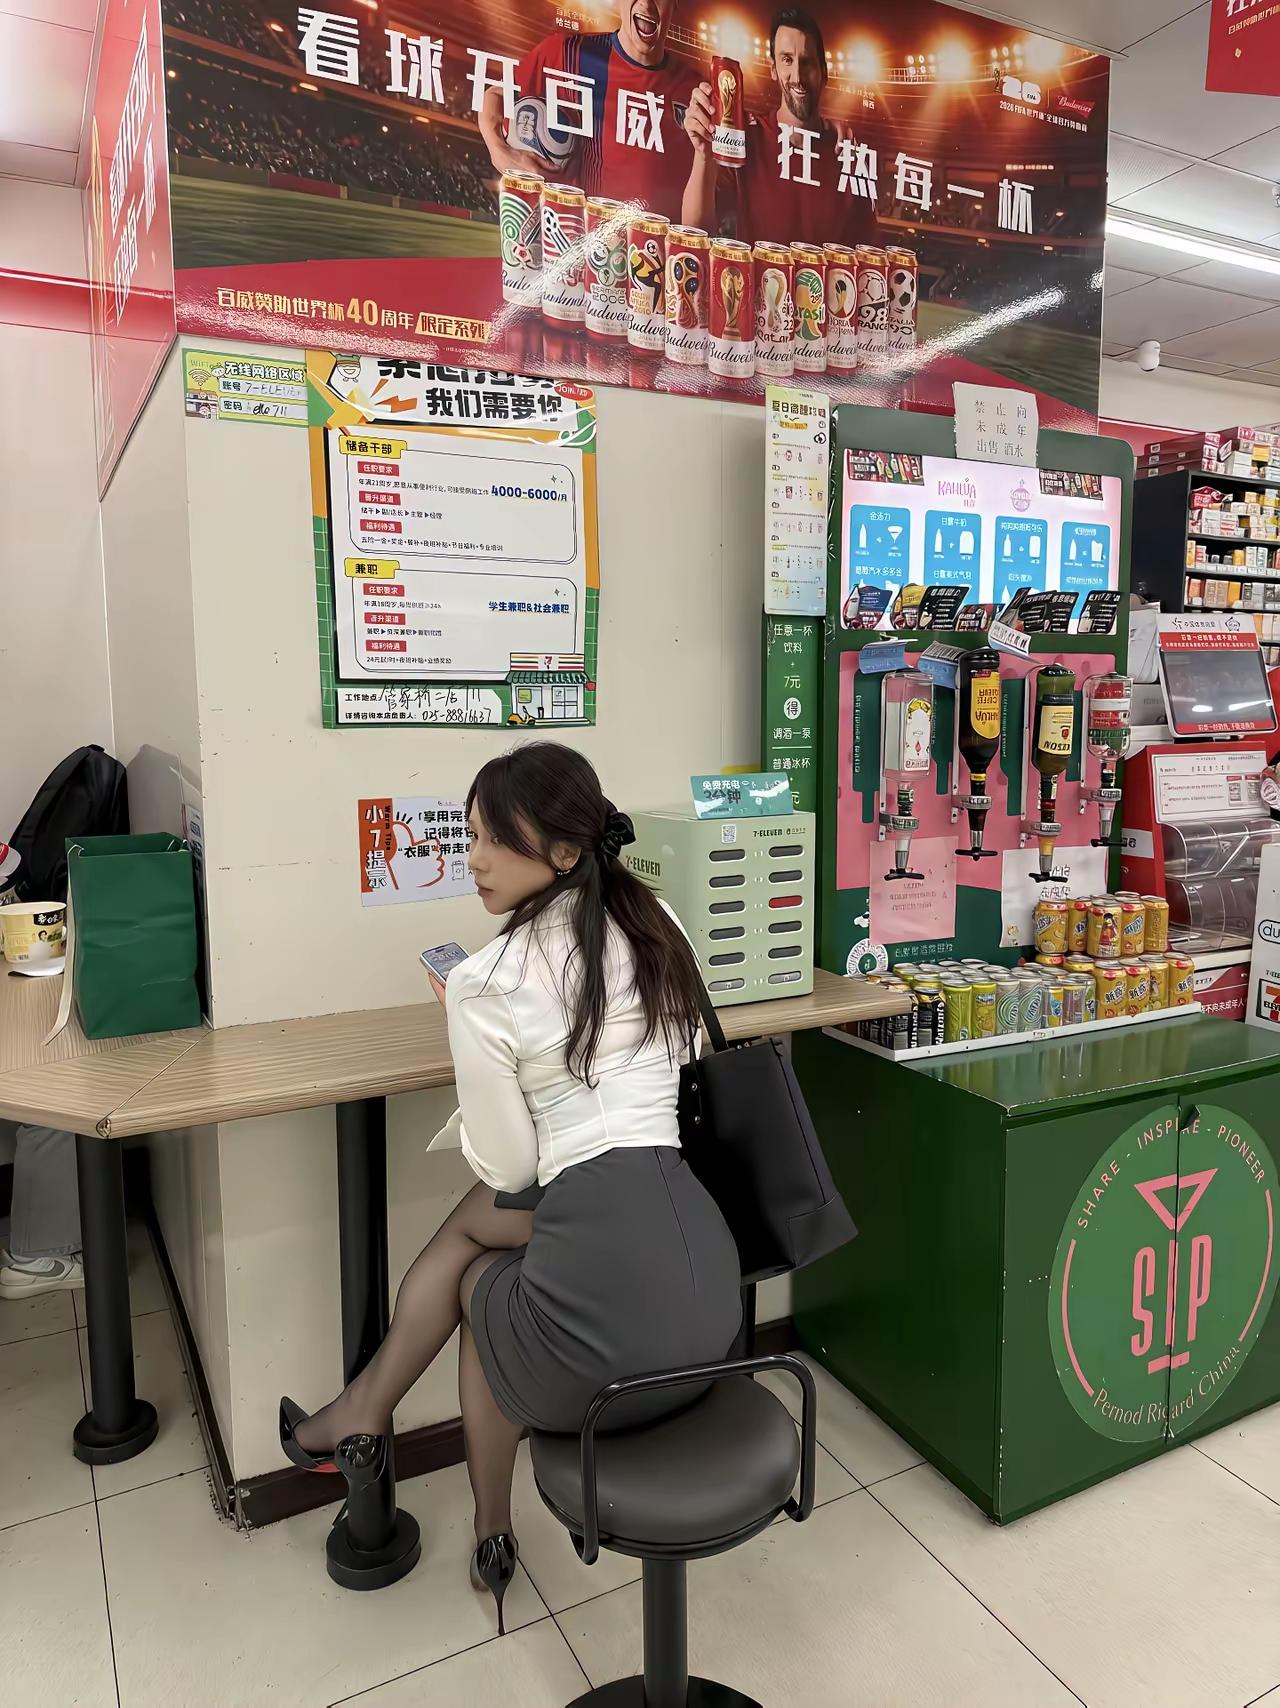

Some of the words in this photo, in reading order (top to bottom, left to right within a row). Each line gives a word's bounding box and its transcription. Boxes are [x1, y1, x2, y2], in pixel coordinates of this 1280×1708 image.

[1057, 96, 1093, 114] Budweiser
[298, 6, 664, 153] 看球开百威
[777, 122, 1034, 234] 狂热每一杯
[225, 361, 305, 382] 无线网络区域
[222, 380, 241, 391] 账号
[223, 400, 243, 411] 密码
[426, 387, 563, 422] 我们需要你
[975, 400, 1027, 418] 禁止向
[976, 420, 1027, 438] 未成年
[345, 440, 393, 455] 储备干部
[363, 464, 393, 474] 任职要求
[491, 485, 567, 502] 4000-6000/月
[366, 521, 396, 531] 福利待遇
[355, 563, 379, 575] 兼职
[368, 586, 399, 595] 任职要求
[488, 601, 570, 615] 学生兼职&社会兼职
[773, 624, 813, 637] 任意一杯
[371, 642, 400, 651] 福利待遇
[784, 642, 803, 654] 饮料
[783, 675, 801, 689] 7元
[786, 701, 799, 716] 得
[773, 728, 811, 740] 调酒一泵
[772, 757, 811, 770] 普通冰杯
[702, 780, 741, 790] 免费充电
[365, 805, 387, 889] 小7提示
[1076, 1160, 1121, 1228] SHARE
[1217, 1125, 1266, 1184] PIONEER
[1130, 1234, 1213, 1357] SIP
[1094, 1387, 1143, 1426] Pernod
[1198, 1345, 1241, 1396] China
